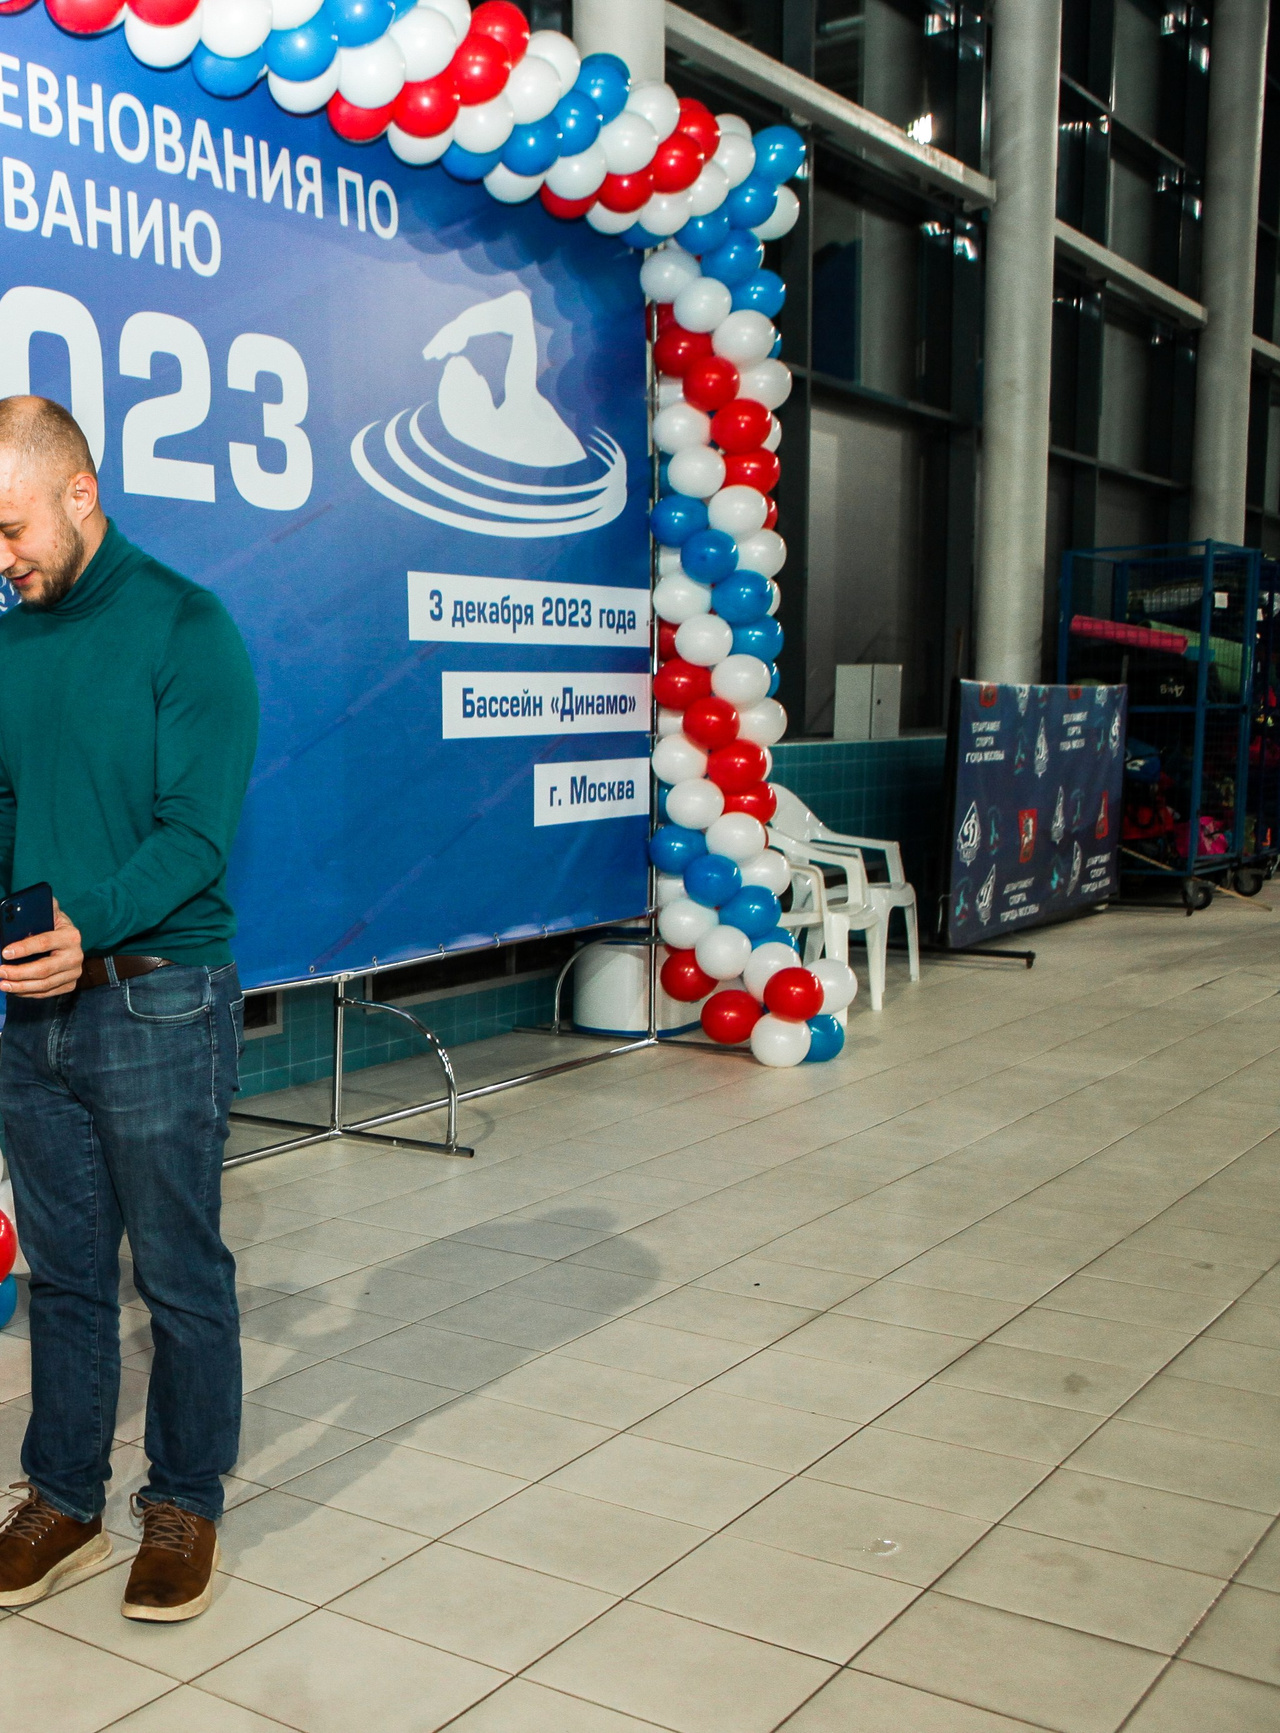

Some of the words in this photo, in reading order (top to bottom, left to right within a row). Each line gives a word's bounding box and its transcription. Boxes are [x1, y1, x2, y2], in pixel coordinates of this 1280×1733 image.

[337, 166, 399, 240] ПО
[429, 588, 443, 622] 3
[451, 594, 535, 634] декабря
[541, 597, 592, 628] 2023
[599, 607, 637, 630] года
[461, 687, 544, 719] Бассейн
[550, 687, 637, 722] «Динамо»
[549, 784, 562, 807] г.
[570, 775, 635, 805] Москва
